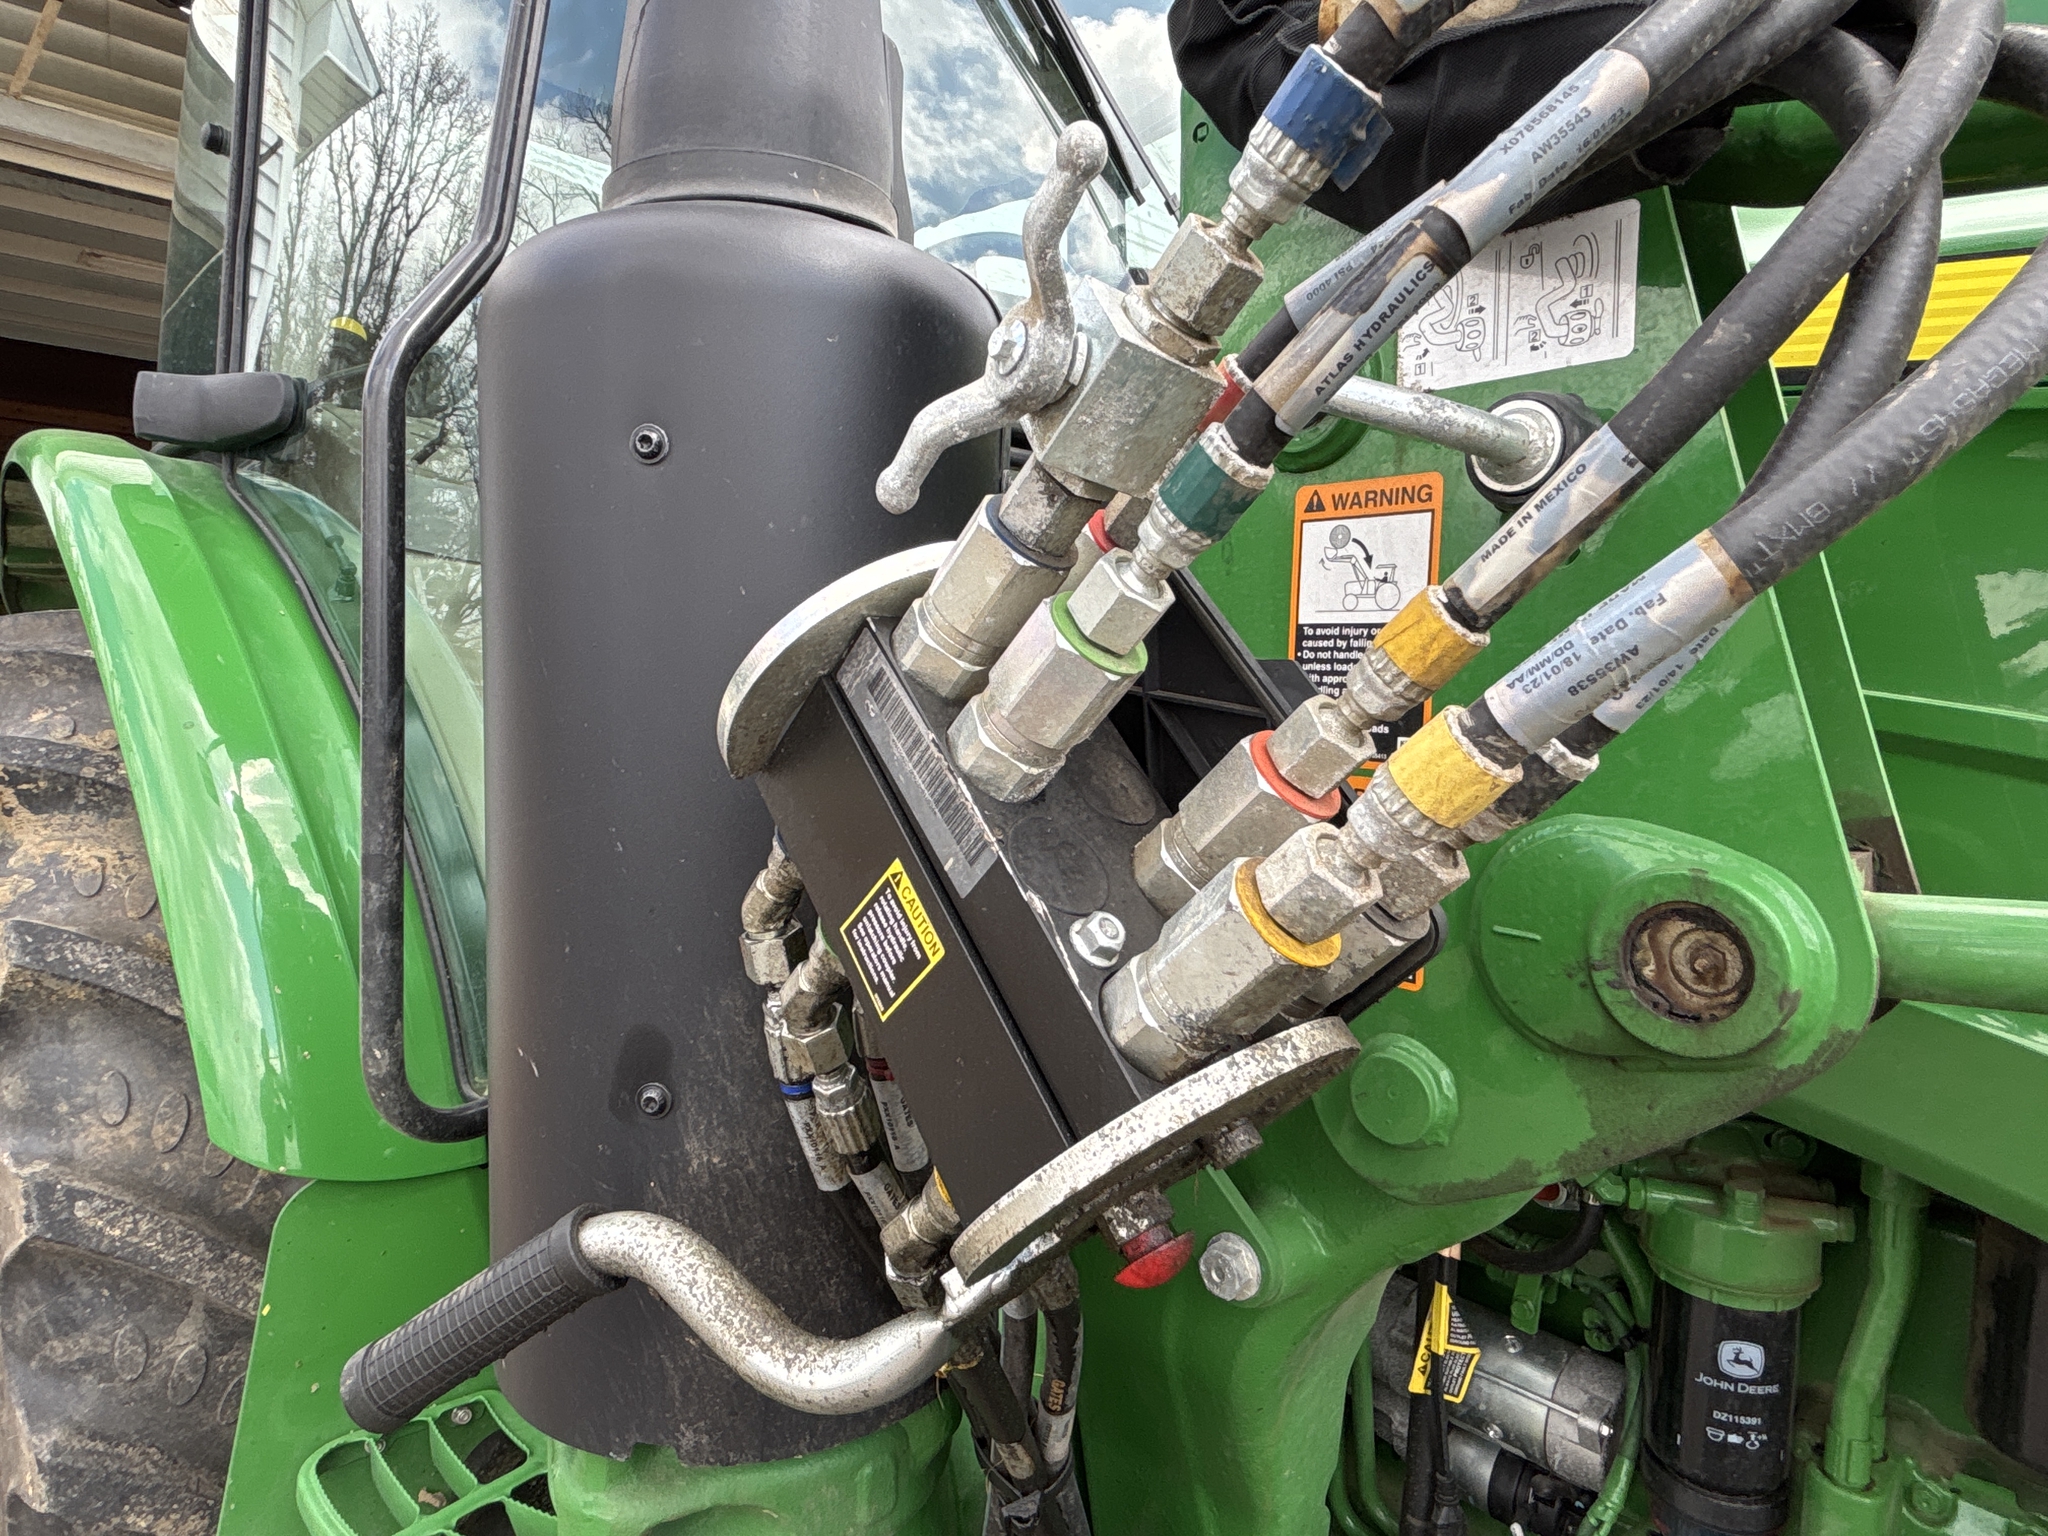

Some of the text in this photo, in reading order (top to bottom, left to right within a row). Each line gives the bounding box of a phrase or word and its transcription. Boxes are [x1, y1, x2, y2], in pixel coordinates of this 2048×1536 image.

[1531, 106, 1592, 164] AW35543
[1315, 352, 1354, 396] ATLAS
[1354, 260, 1435, 352] HYDRAULICS
[1332, 484, 1433, 510] WARNING
[1480, 463, 1587, 562] MADE IN MEXICO
[1628, 592, 1666, 616] Fab.
[1302, 639, 1372, 649] caused by fallin
[1303, 627, 1313, 635] To
[1316, 627, 1340, 635] avoid
[1342, 627, 1368, 637] injury
[1590, 618, 1628, 645] Date
[1302, 662, 1356, 670] unless load
[1506, 640, 1574, 690] DD/MM/AA
[1522, 652, 1582, 694] 18/01/23
[1568, 644, 1640, 696] AW35538
[1636, 627, 1718, 710] Date 14/01/23
[879, 895, 894, 926] rotating
[885, 887, 921, 960] To avoid injury from
[901, 886, 940, 957] CAUTION
[874, 902, 905, 963] release hydraulic
[883, 939, 896, 965] before
[880, 970, 896, 998] manual
[1048, 1380, 1066, 1412] GATES
[1694, 1372, 1780, 1394] JOHN DEERE
